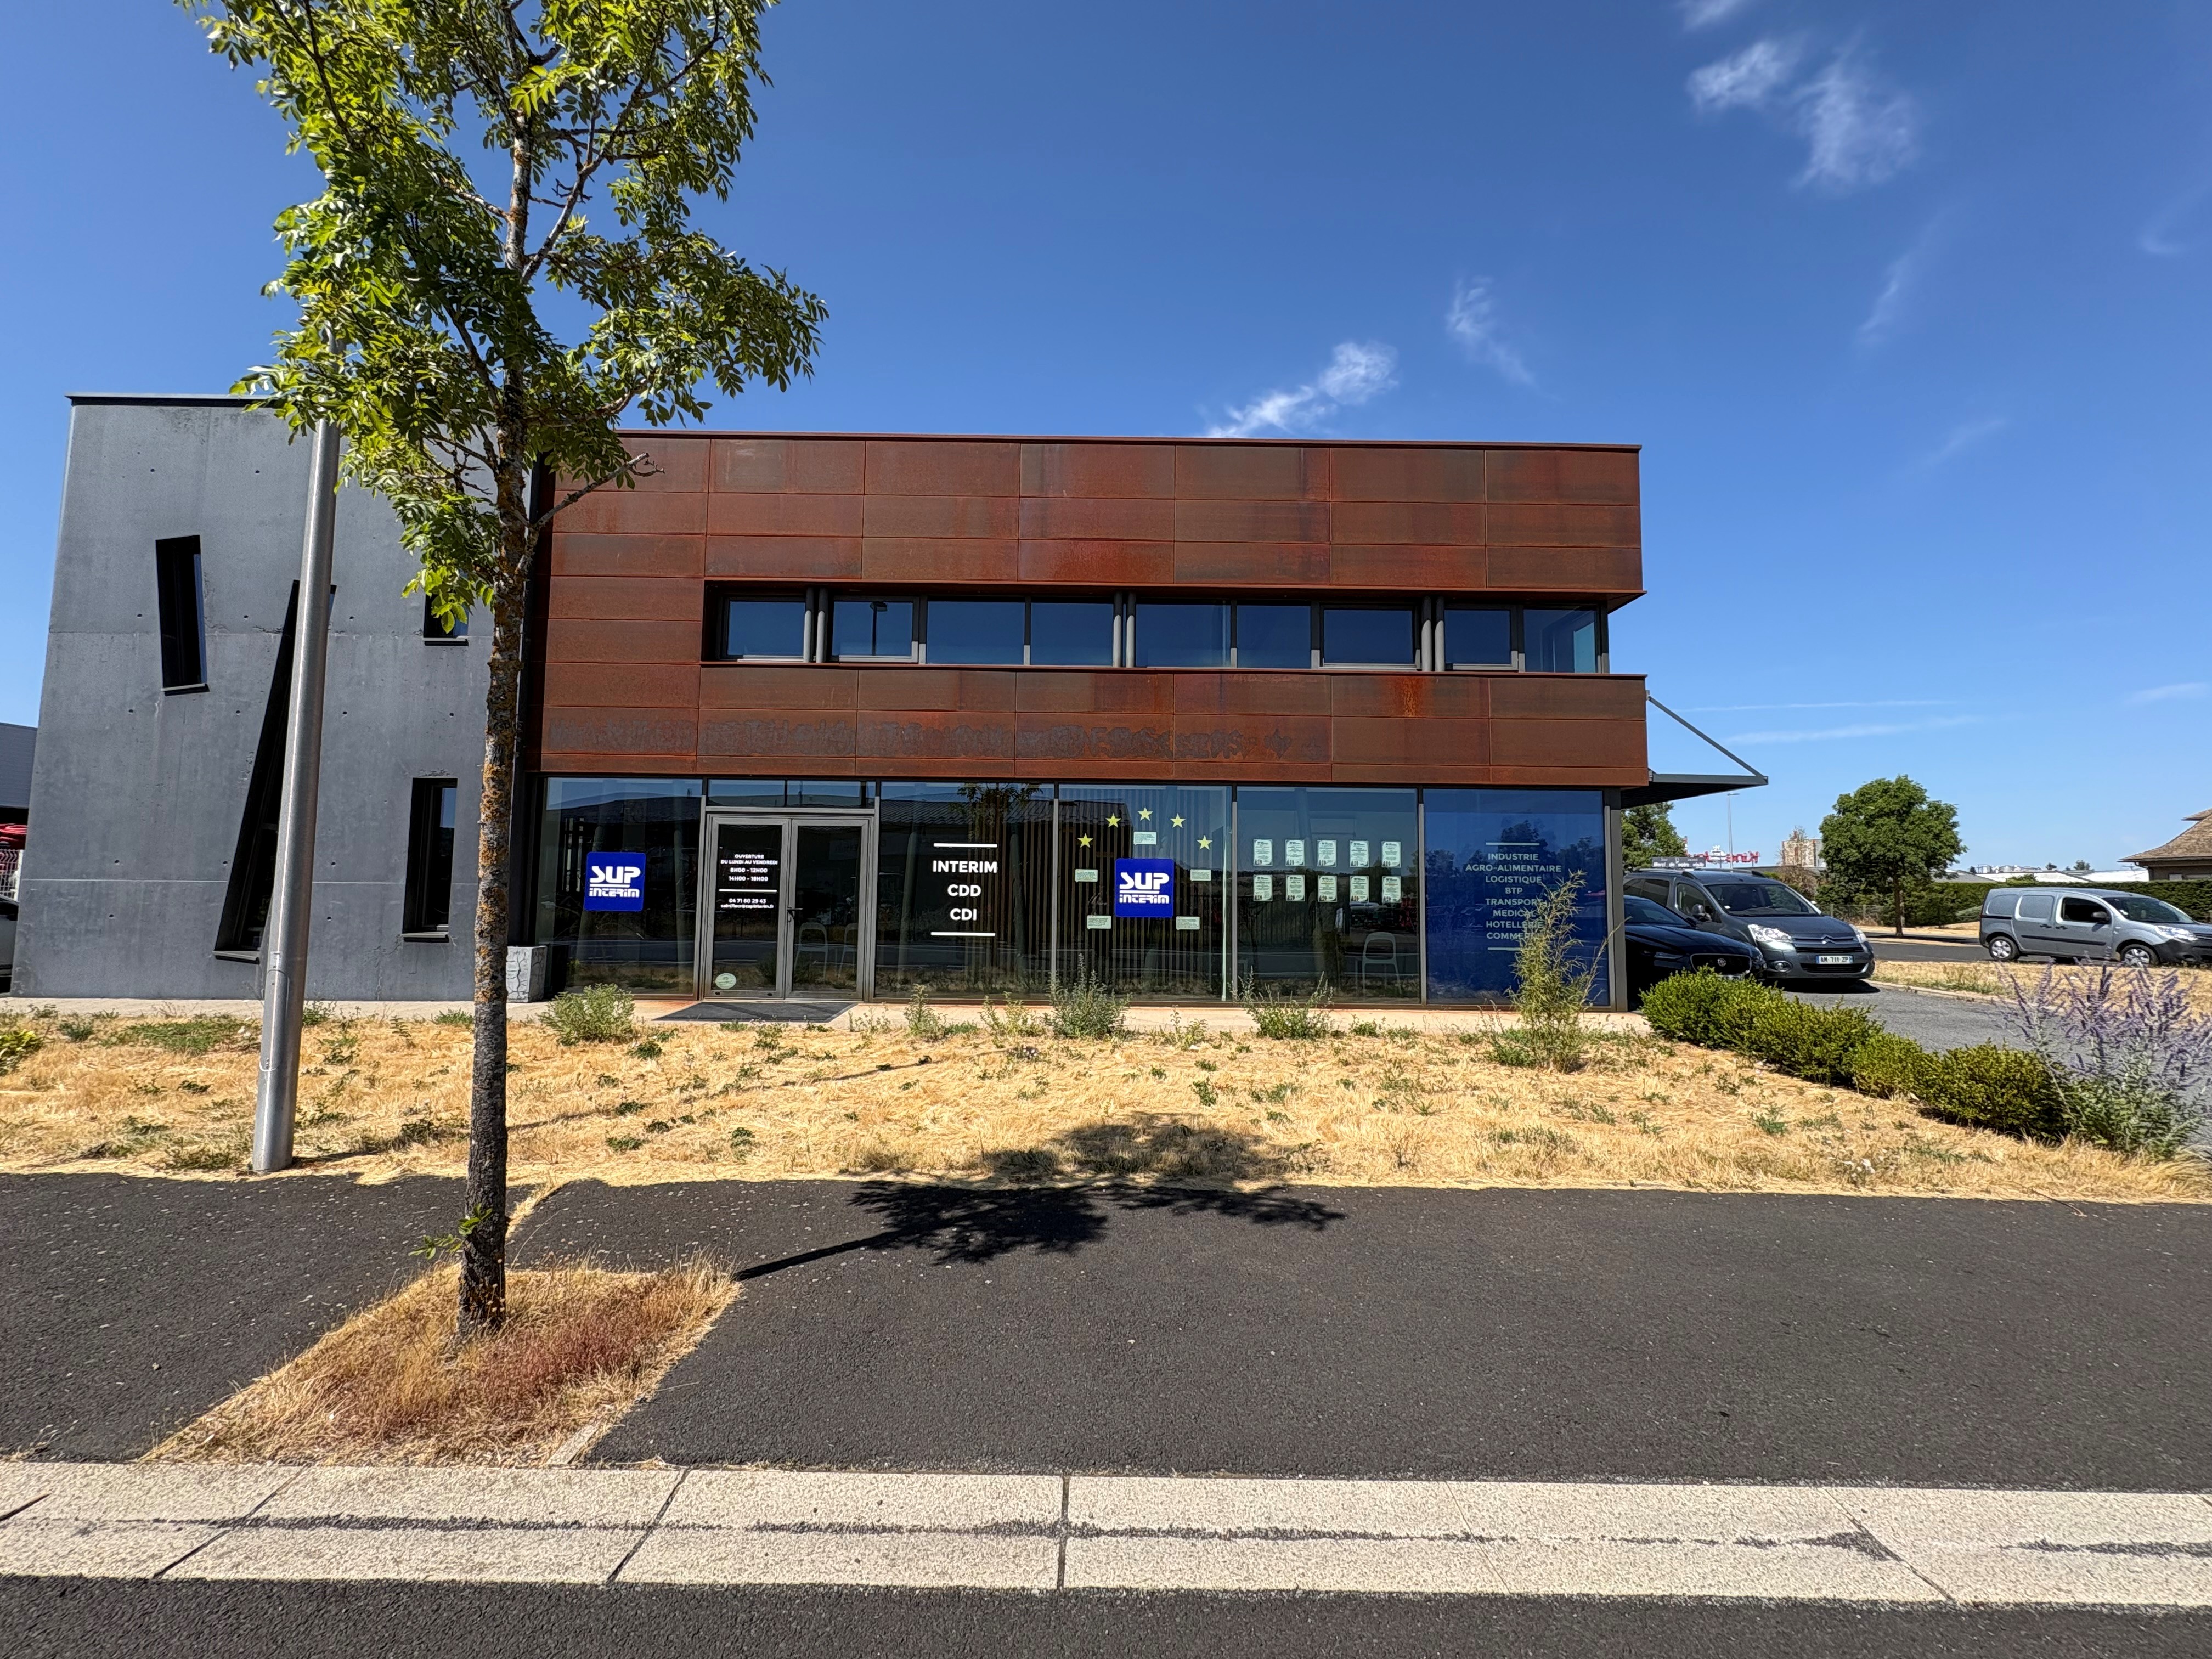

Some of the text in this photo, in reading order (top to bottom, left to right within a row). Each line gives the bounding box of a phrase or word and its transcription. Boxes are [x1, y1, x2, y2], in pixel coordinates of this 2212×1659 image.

[933, 860, 997, 873] INTERIM
[1465, 864, 1562, 872] AGRO-ALIMENTAIRE
[590, 866, 641, 884] SUP
[1119, 872, 1170, 890] SUP
[1485, 876, 1542, 884] LOGISTIQUE
[947, 884, 981, 896] CDD
[950, 909, 977, 921] CDI
